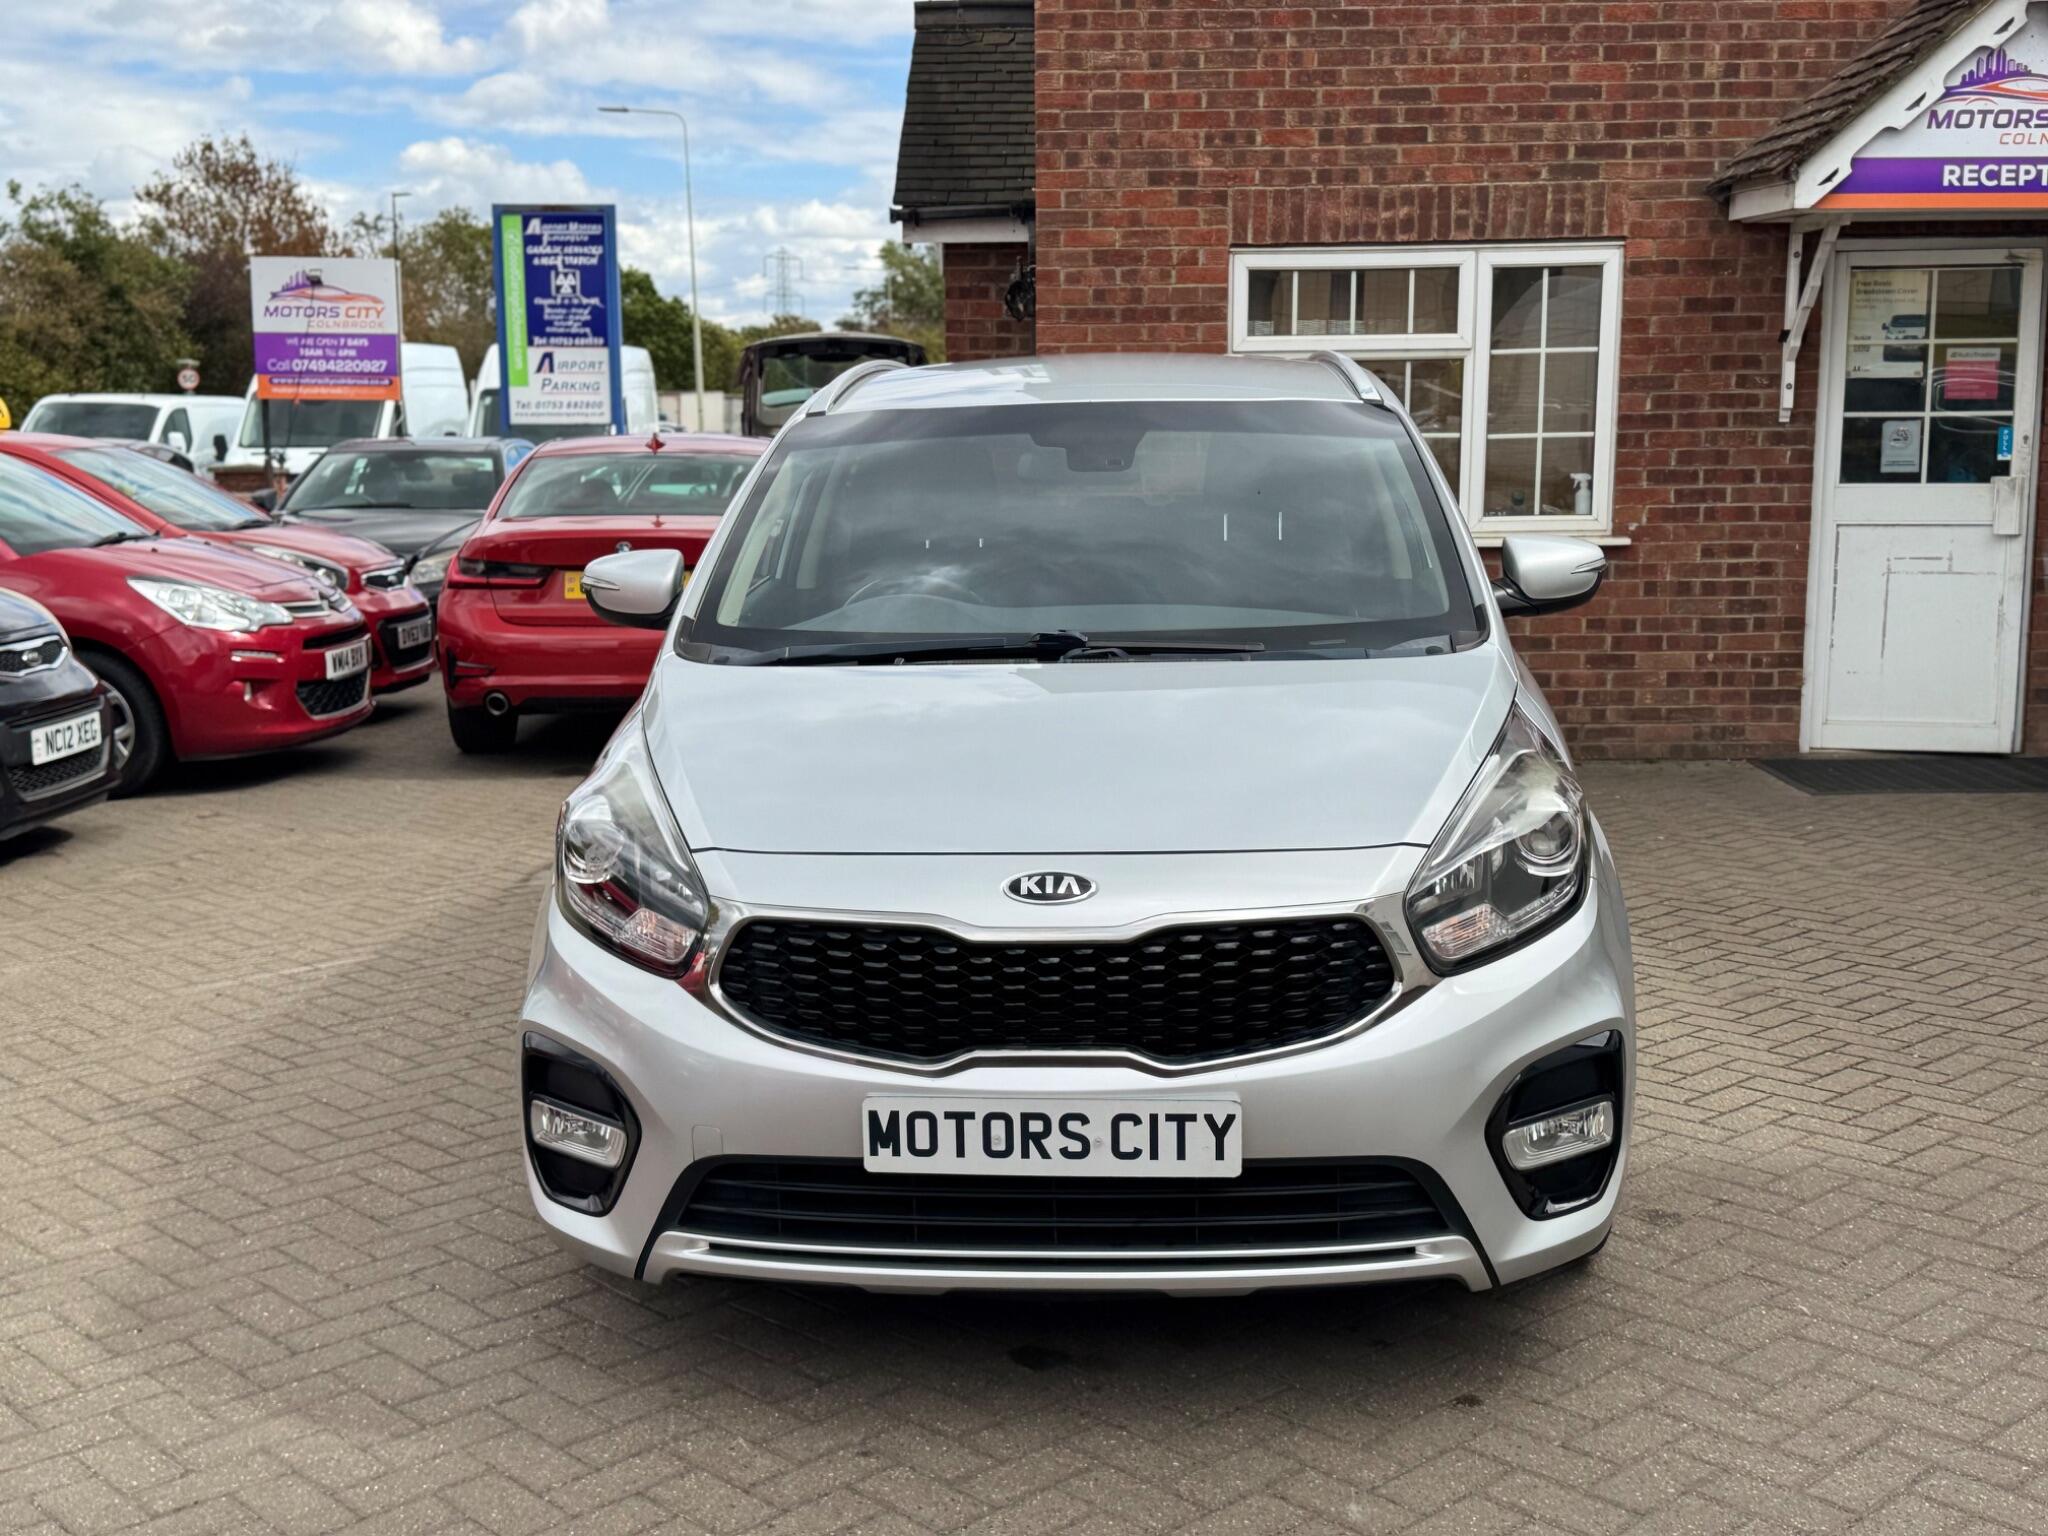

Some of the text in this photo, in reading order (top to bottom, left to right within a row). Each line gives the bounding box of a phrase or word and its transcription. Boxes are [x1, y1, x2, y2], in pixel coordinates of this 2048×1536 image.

[1926, 109, 2048, 129] MOTORS
[264, 306, 385, 318] MOTORS CITY
[308, 320, 385, 329] COLNBROOK
[315, 337, 338, 346] OPEN
[346, 337, 369, 347] DAYS
[266, 358, 388, 373] Call 07494220927
[535, 351, 605, 374] AIRPORT
[540, 377, 601, 392] PARKING
[45, 717, 98, 756] NC12 XEG
[1020, 875, 1081, 895] KIA
[867, 1110, 1236, 1161] MOTORS CITY
